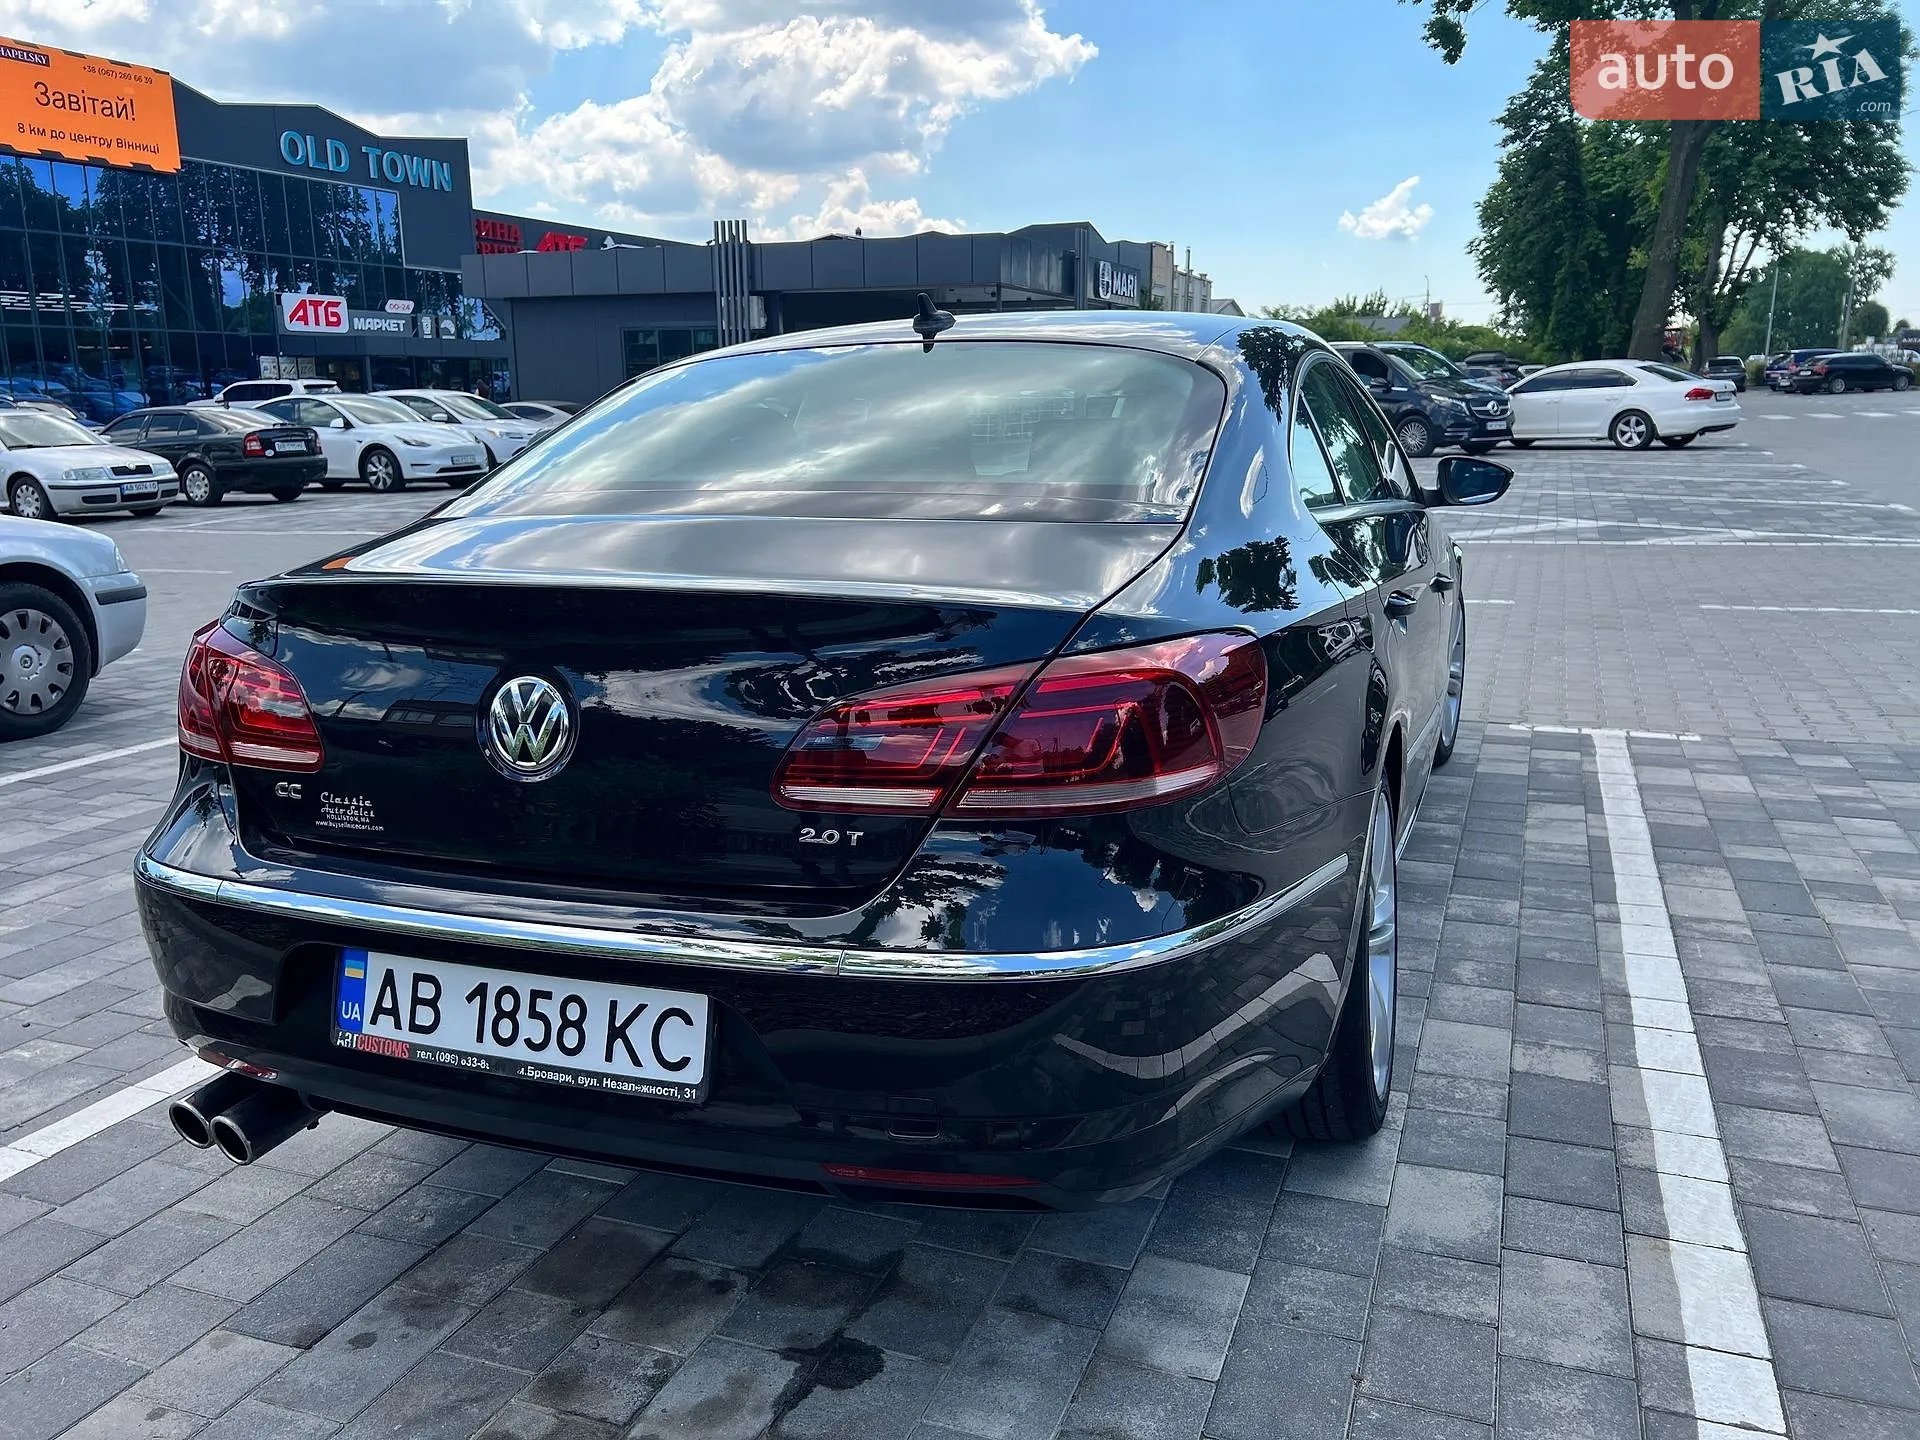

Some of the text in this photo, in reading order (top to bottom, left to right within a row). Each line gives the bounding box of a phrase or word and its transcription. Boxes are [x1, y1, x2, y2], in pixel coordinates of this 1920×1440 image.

[34, 81, 136, 121] Завітай!
[17, 122, 26, 134] 8
[50, 130, 66, 140] до
[69, 133, 113, 149] центру
[116, 138, 160, 154] Вінниці
[280, 131, 452, 192] OLD TOWN
[288, 298, 343, 328] АТБ
[353, 316, 406, 332] МАРКЕТ
[275, 782, 302, 799] CC
[320, 791, 373, 807] Classic
[320, 804, 375, 818] Auto Sales
[846, 831, 864, 846] T
[342, 1000, 361, 1022] UA
[369, 968, 695, 1072] AB 1858 KC
[416, 1049, 435, 1061] тел.
[578, 1076, 600, 1088] вул.
[684, 1087, 697, 1100] 31
